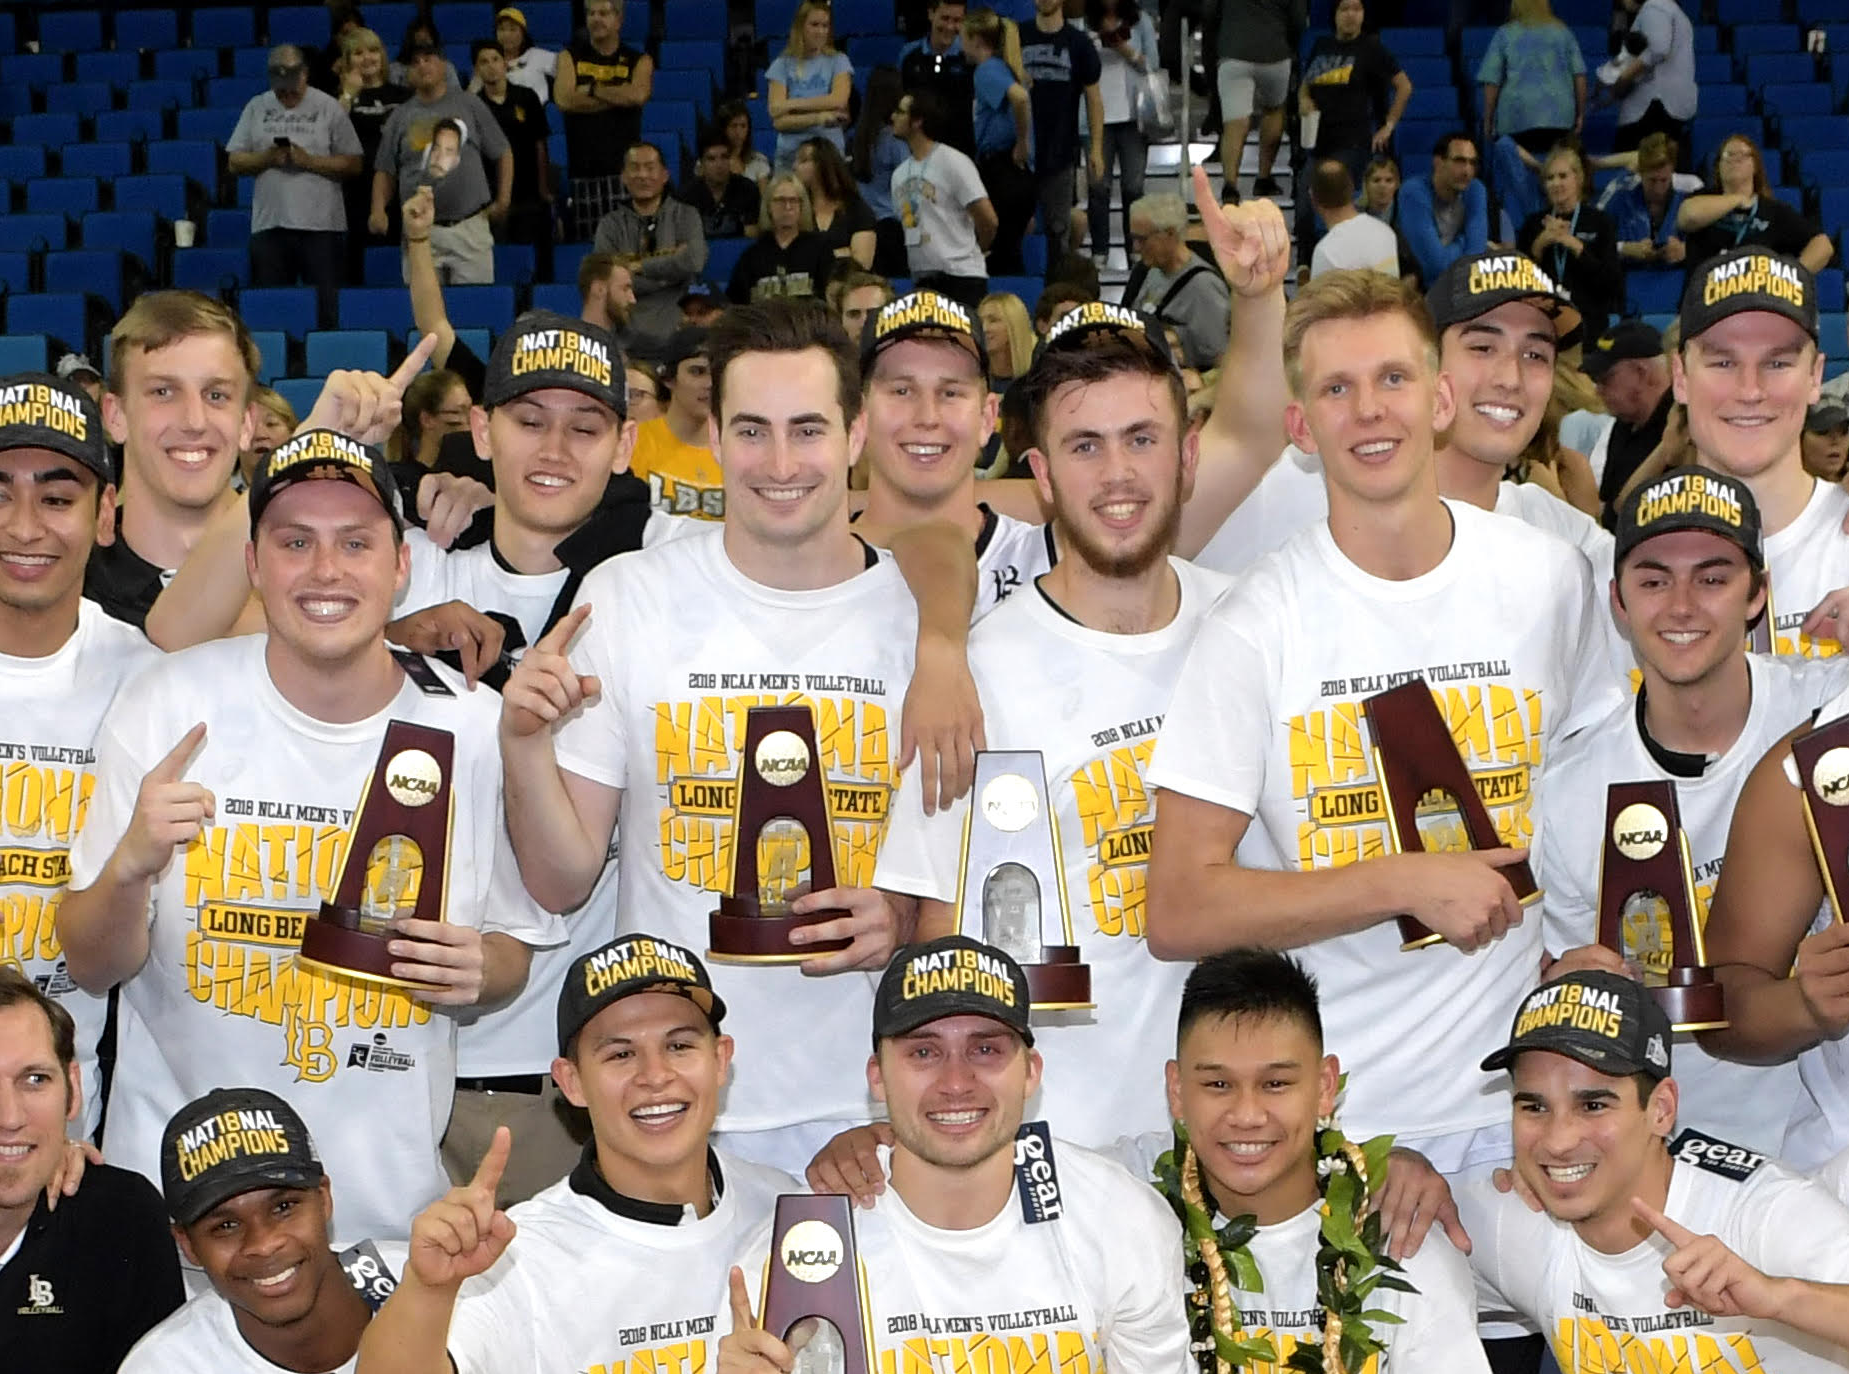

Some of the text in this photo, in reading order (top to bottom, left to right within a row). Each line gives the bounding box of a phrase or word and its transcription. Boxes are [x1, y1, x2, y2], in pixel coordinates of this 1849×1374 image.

[688, 673, 717, 689] 2018
[759, 674, 800, 691] MEN'S
[805, 675, 887, 696] VOLLEYBALL
[1320, 681, 1347, 698] 2018
[1428, 660, 1511, 685] VOLLEYBALL
[759, 757, 811, 774] NCAA
[390, 773, 439, 795] NCAA
[225, 798, 254, 816] 2018
[296, 804, 338, 824] MEN'S
[1319, 789, 1379, 818] LONG
[1619, 829, 1666, 847] NCAA
[208, 908, 270, 938] LONG
[902, 966, 1015, 1007] CHAMPIONS
[179, 1128, 290, 1181] CHAMPIONS
[1674, 1138, 1768, 1167] gear
[1014, 1134, 1063, 1221] gear
[787, 1249, 842, 1268] NCAA
[28, 1274, 55, 1306] LB
[16, 1305, 64, 1315] VOLLEYBALL
[886, 1313, 917, 1335] 2018
[988, 1304, 1078, 1333] VOLLEYBALL
[617, 1327, 648, 1347] 2018
